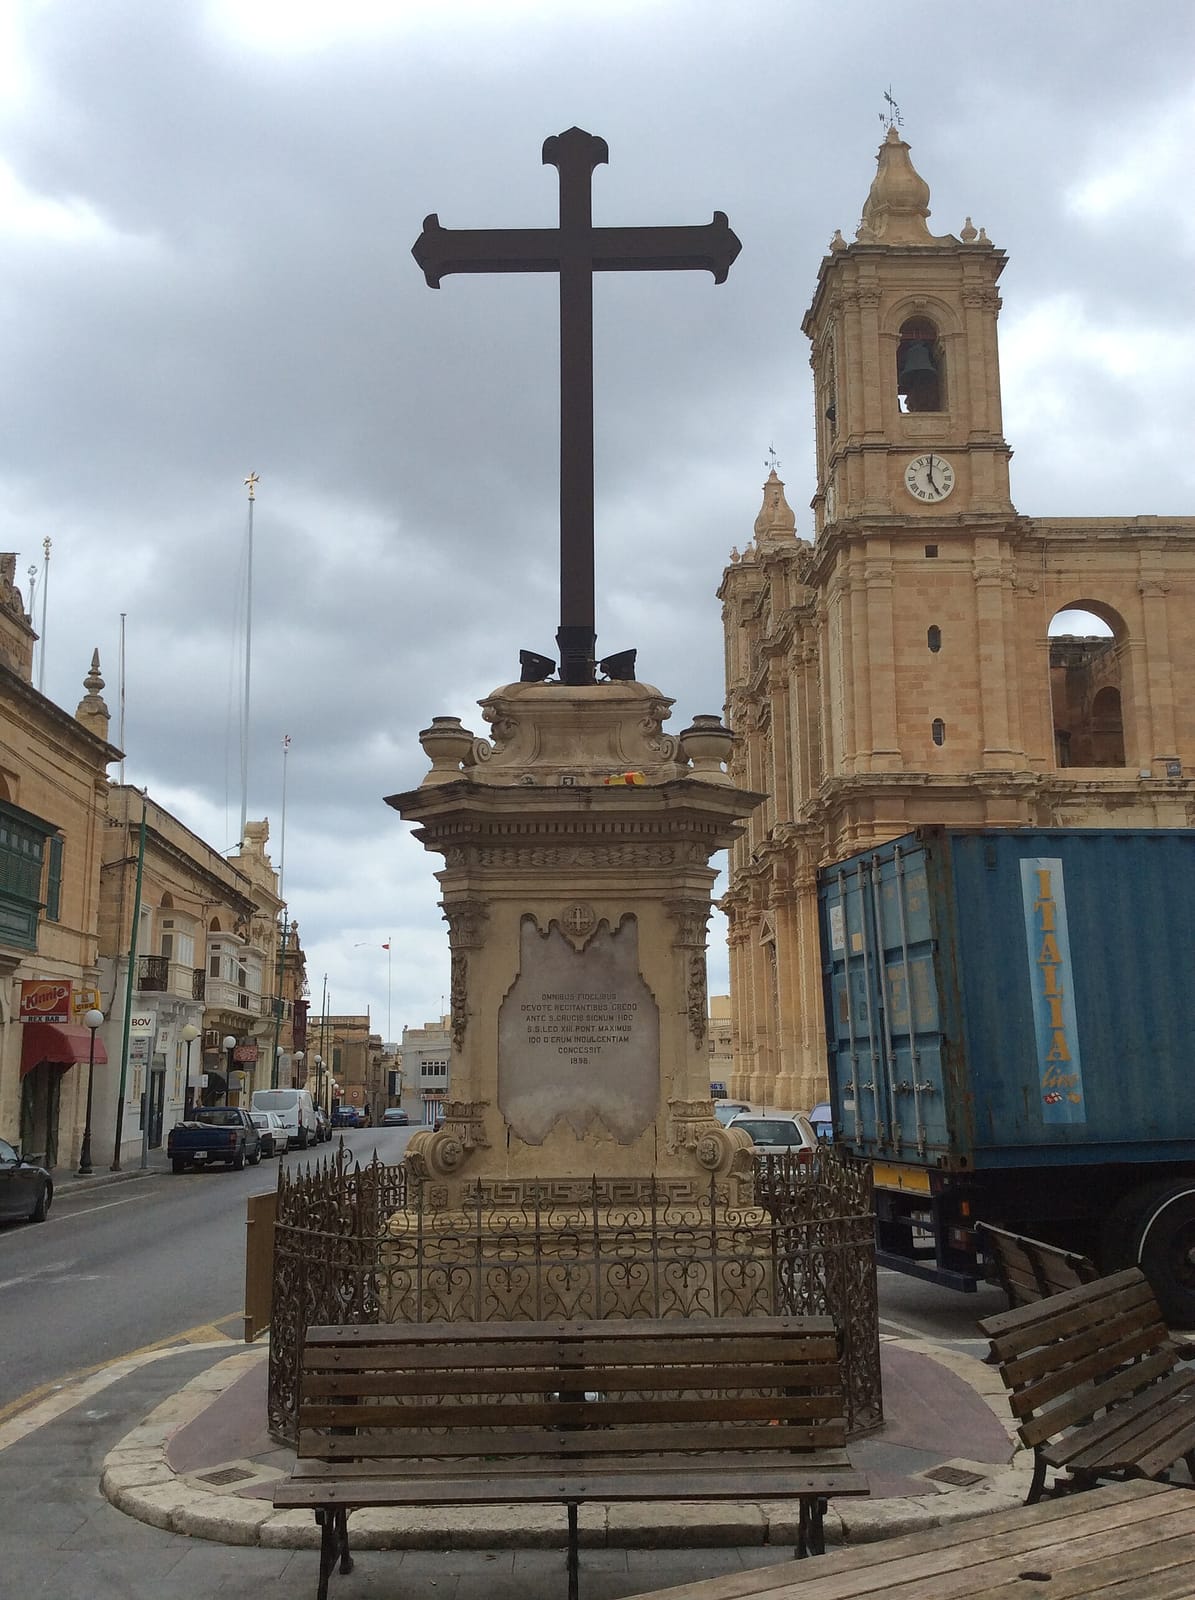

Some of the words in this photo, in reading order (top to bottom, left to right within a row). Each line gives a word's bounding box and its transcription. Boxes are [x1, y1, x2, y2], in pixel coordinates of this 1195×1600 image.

[1033, 869, 1072, 1062] ITALIA
[26, 987, 66, 1008] Kinnie
[520, 1004, 553, 1012] DEVOTE
[611, 1003, 638, 1011] CREDO
[131, 1018, 151, 1027] BOV
[573, 1035, 629, 1043] INDULGENTIAM
[558, 1046, 602, 1054] CONCESSIT
